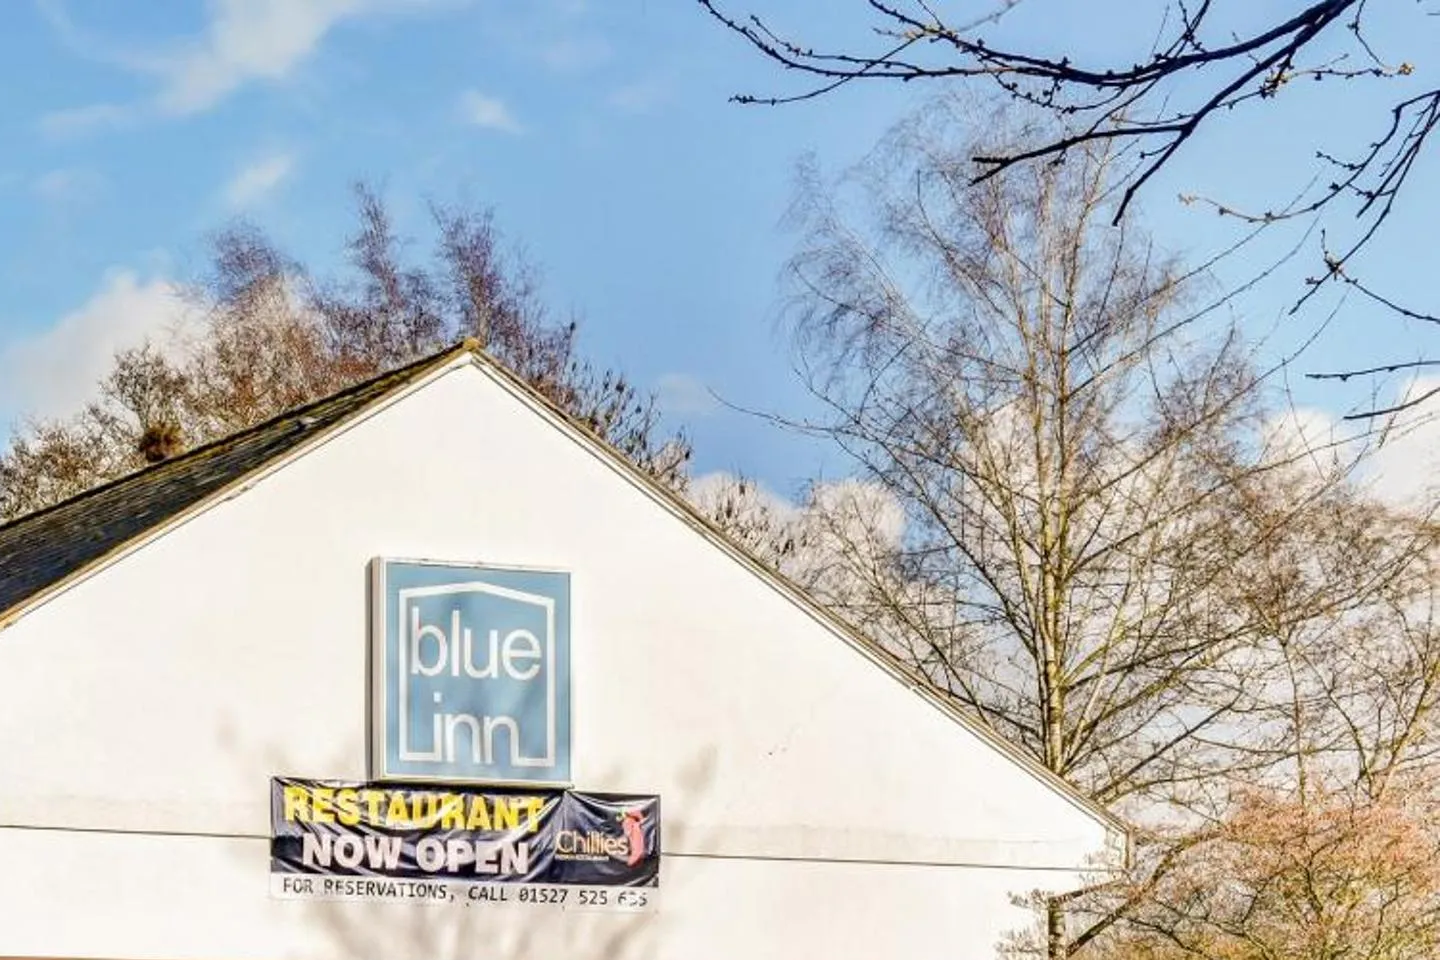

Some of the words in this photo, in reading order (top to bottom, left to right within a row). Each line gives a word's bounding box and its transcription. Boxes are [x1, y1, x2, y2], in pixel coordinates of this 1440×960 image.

[411, 606, 542, 681] blue
[433, 691, 520, 767] inn
[283, 784, 545, 833] RESTAURANT
[302, 832, 402, 870] NOW
[416, 838, 529, 875] OPEN
[555, 830, 629, 856] Chillies
[283, 877, 314, 895] FOR
[324, 879, 455, 902] RESERVATIONS,
[468, 886, 507, 902] CALL
[520, 887, 568, 905] 01527
[580, 890, 607, 905] 525
